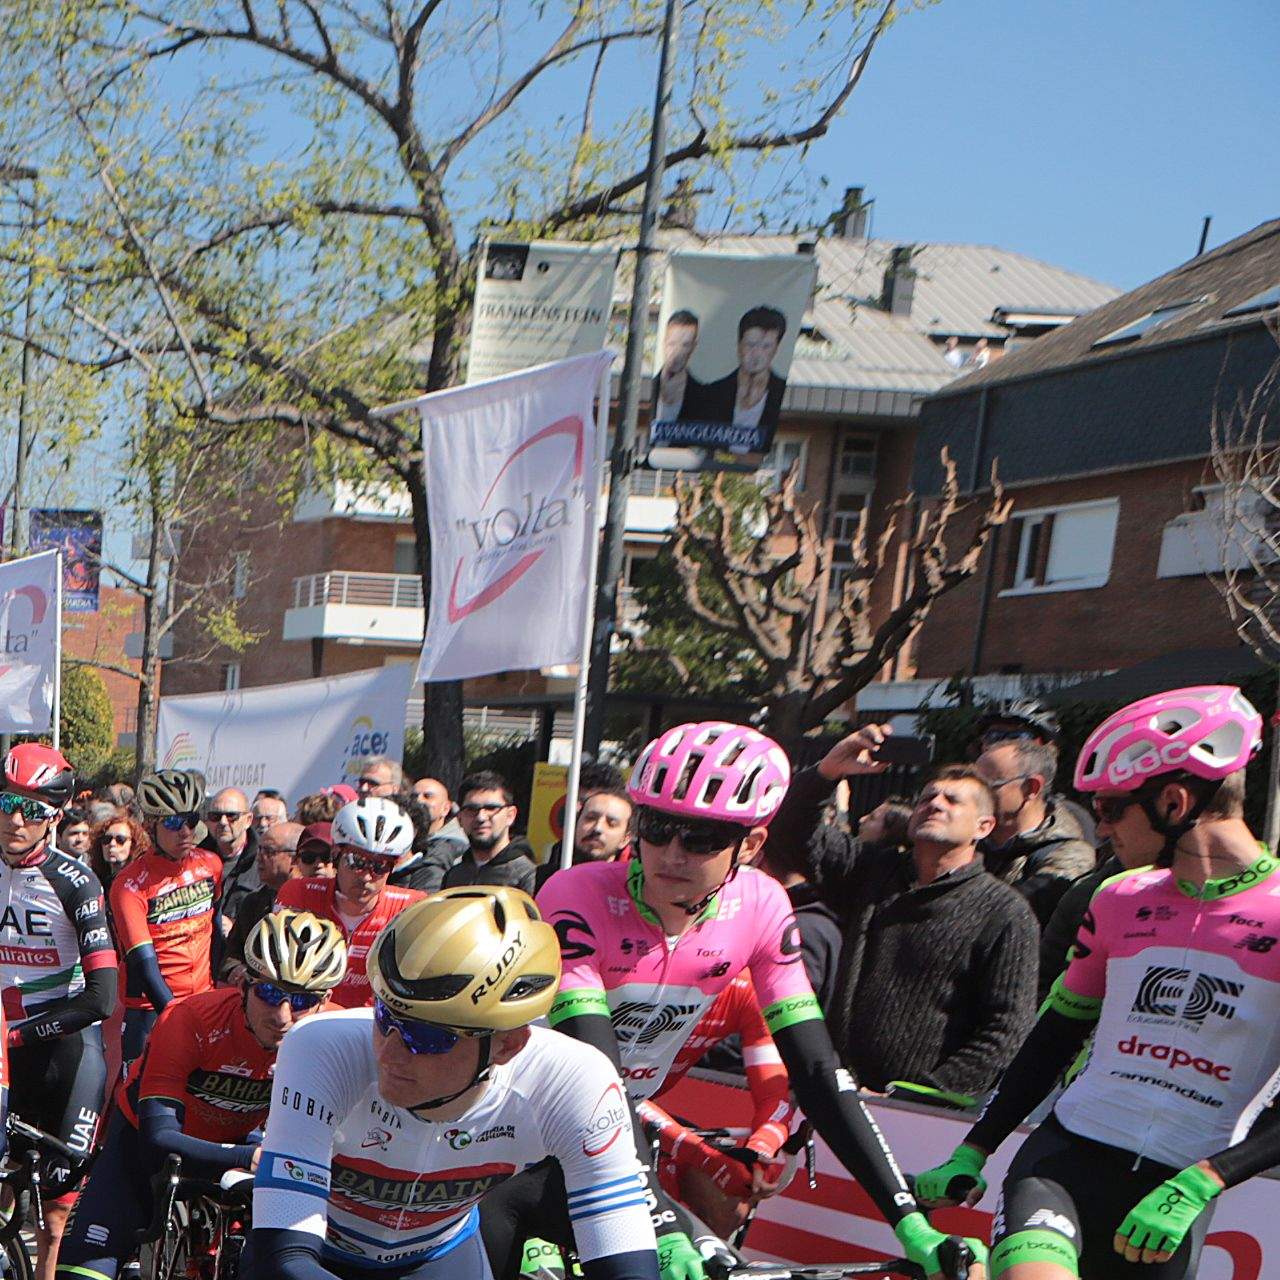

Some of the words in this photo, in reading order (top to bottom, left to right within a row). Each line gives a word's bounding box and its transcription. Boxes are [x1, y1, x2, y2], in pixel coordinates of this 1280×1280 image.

[479, 303, 602, 325] FRANKENSTEIN
[352, 731, 389, 755] aces
[207, 766, 231, 788] SANT
[233, 763, 267, 787] CUGAT
[58, 861, 90, 888] UAE
[470, 931, 523, 1006] RUDY
[35, 1021, 64, 1037] UAE
[1117, 1035, 1233, 1082] drapac
[201, 1073, 272, 1102] BAHRA
[1109, 1070, 1224, 1109] cannondale
[281, 1086, 335, 1126] GOBIK
[66, 1106, 97, 1152] UAE
[339, 1169, 492, 1200] BAHRAIN
